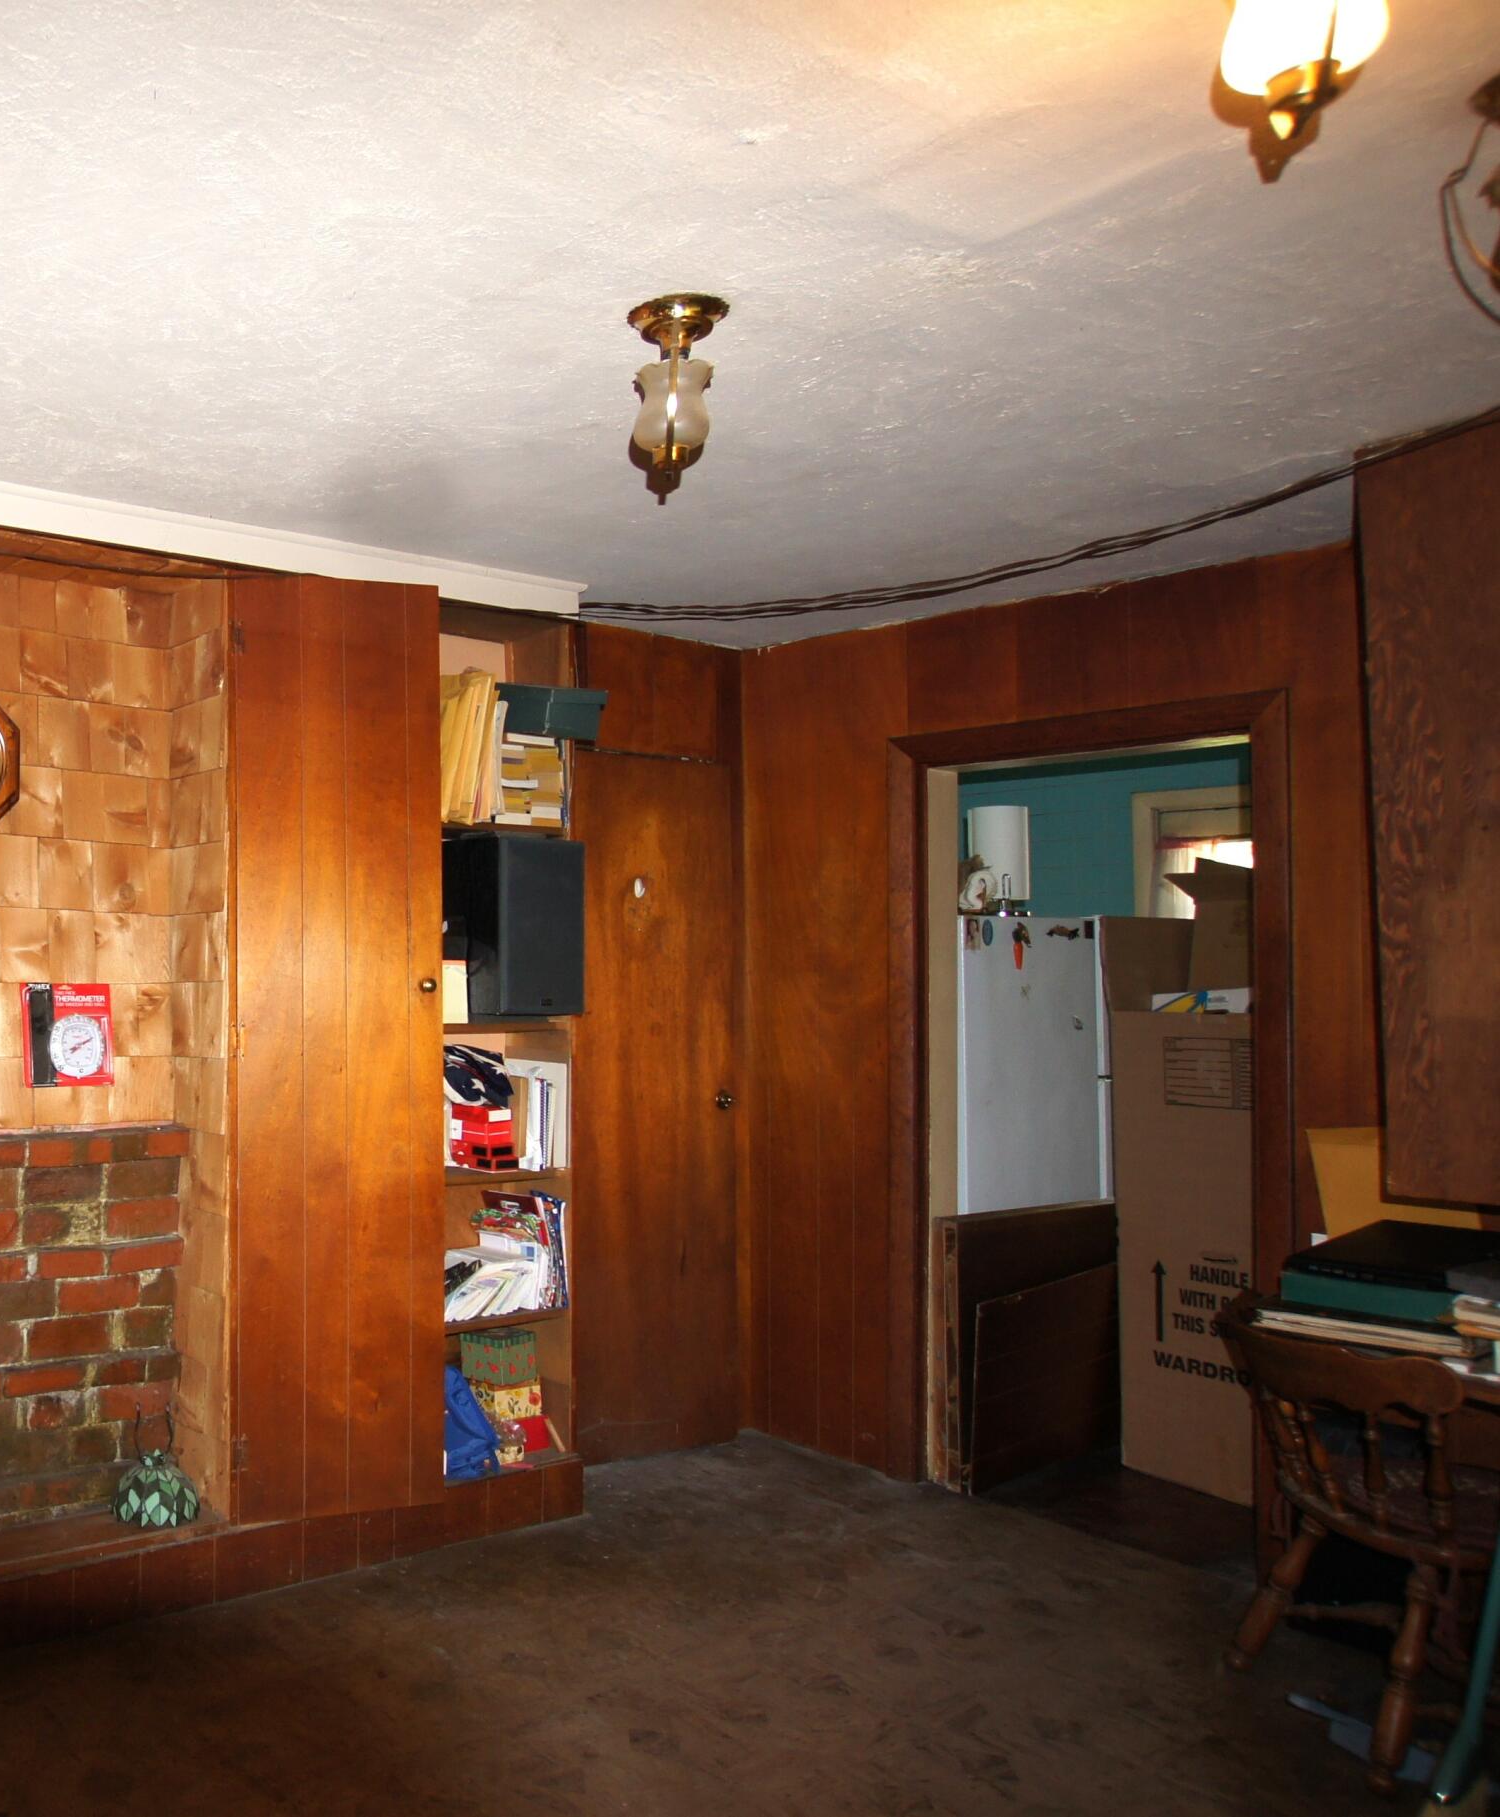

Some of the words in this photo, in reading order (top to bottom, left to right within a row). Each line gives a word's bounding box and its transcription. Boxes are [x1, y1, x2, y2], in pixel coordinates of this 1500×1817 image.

[54, 995, 106, 1003] THERMOMETER
[1189, 1263, 1249, 1290] HANDLE
[1179, 1287, 1217, 1311] WITH
[1172, 1312, 1206, 1335] THIS
